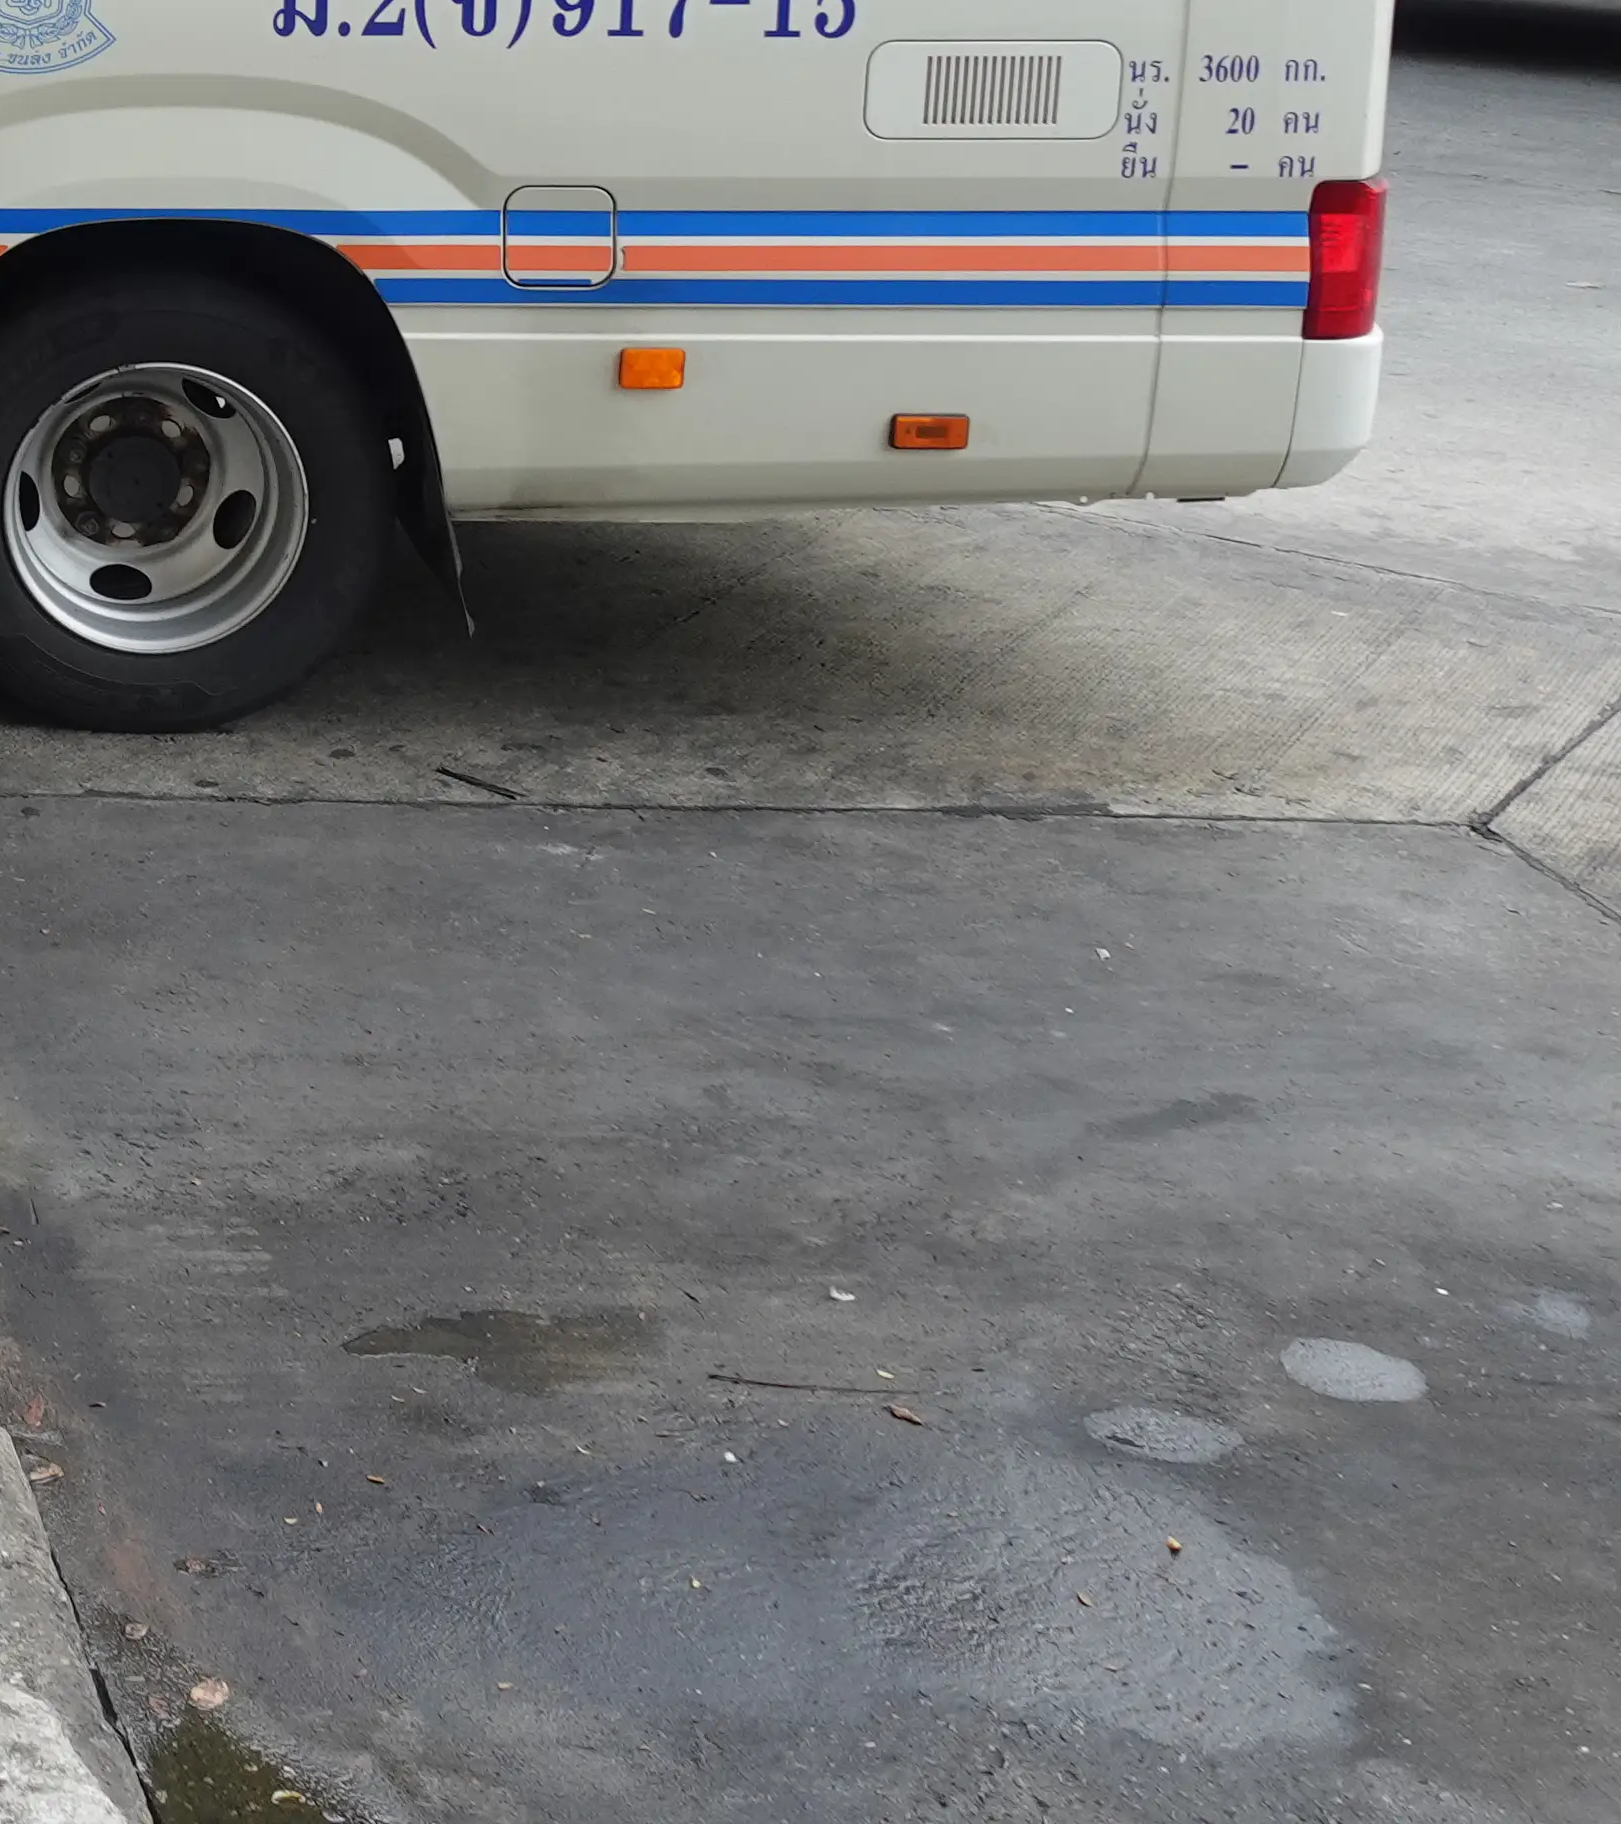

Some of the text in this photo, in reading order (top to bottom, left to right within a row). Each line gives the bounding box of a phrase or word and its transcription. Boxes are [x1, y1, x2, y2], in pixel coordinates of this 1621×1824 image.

[1198, 54, 1260, 83] 3600
[1284, 58, 1326, 82] กก.
[1124, 87, 1320, 135] นั่ง 20 คน
[1120, 141, 1157, 179] ยืน
[1278, 155, 1316, 178] คน
